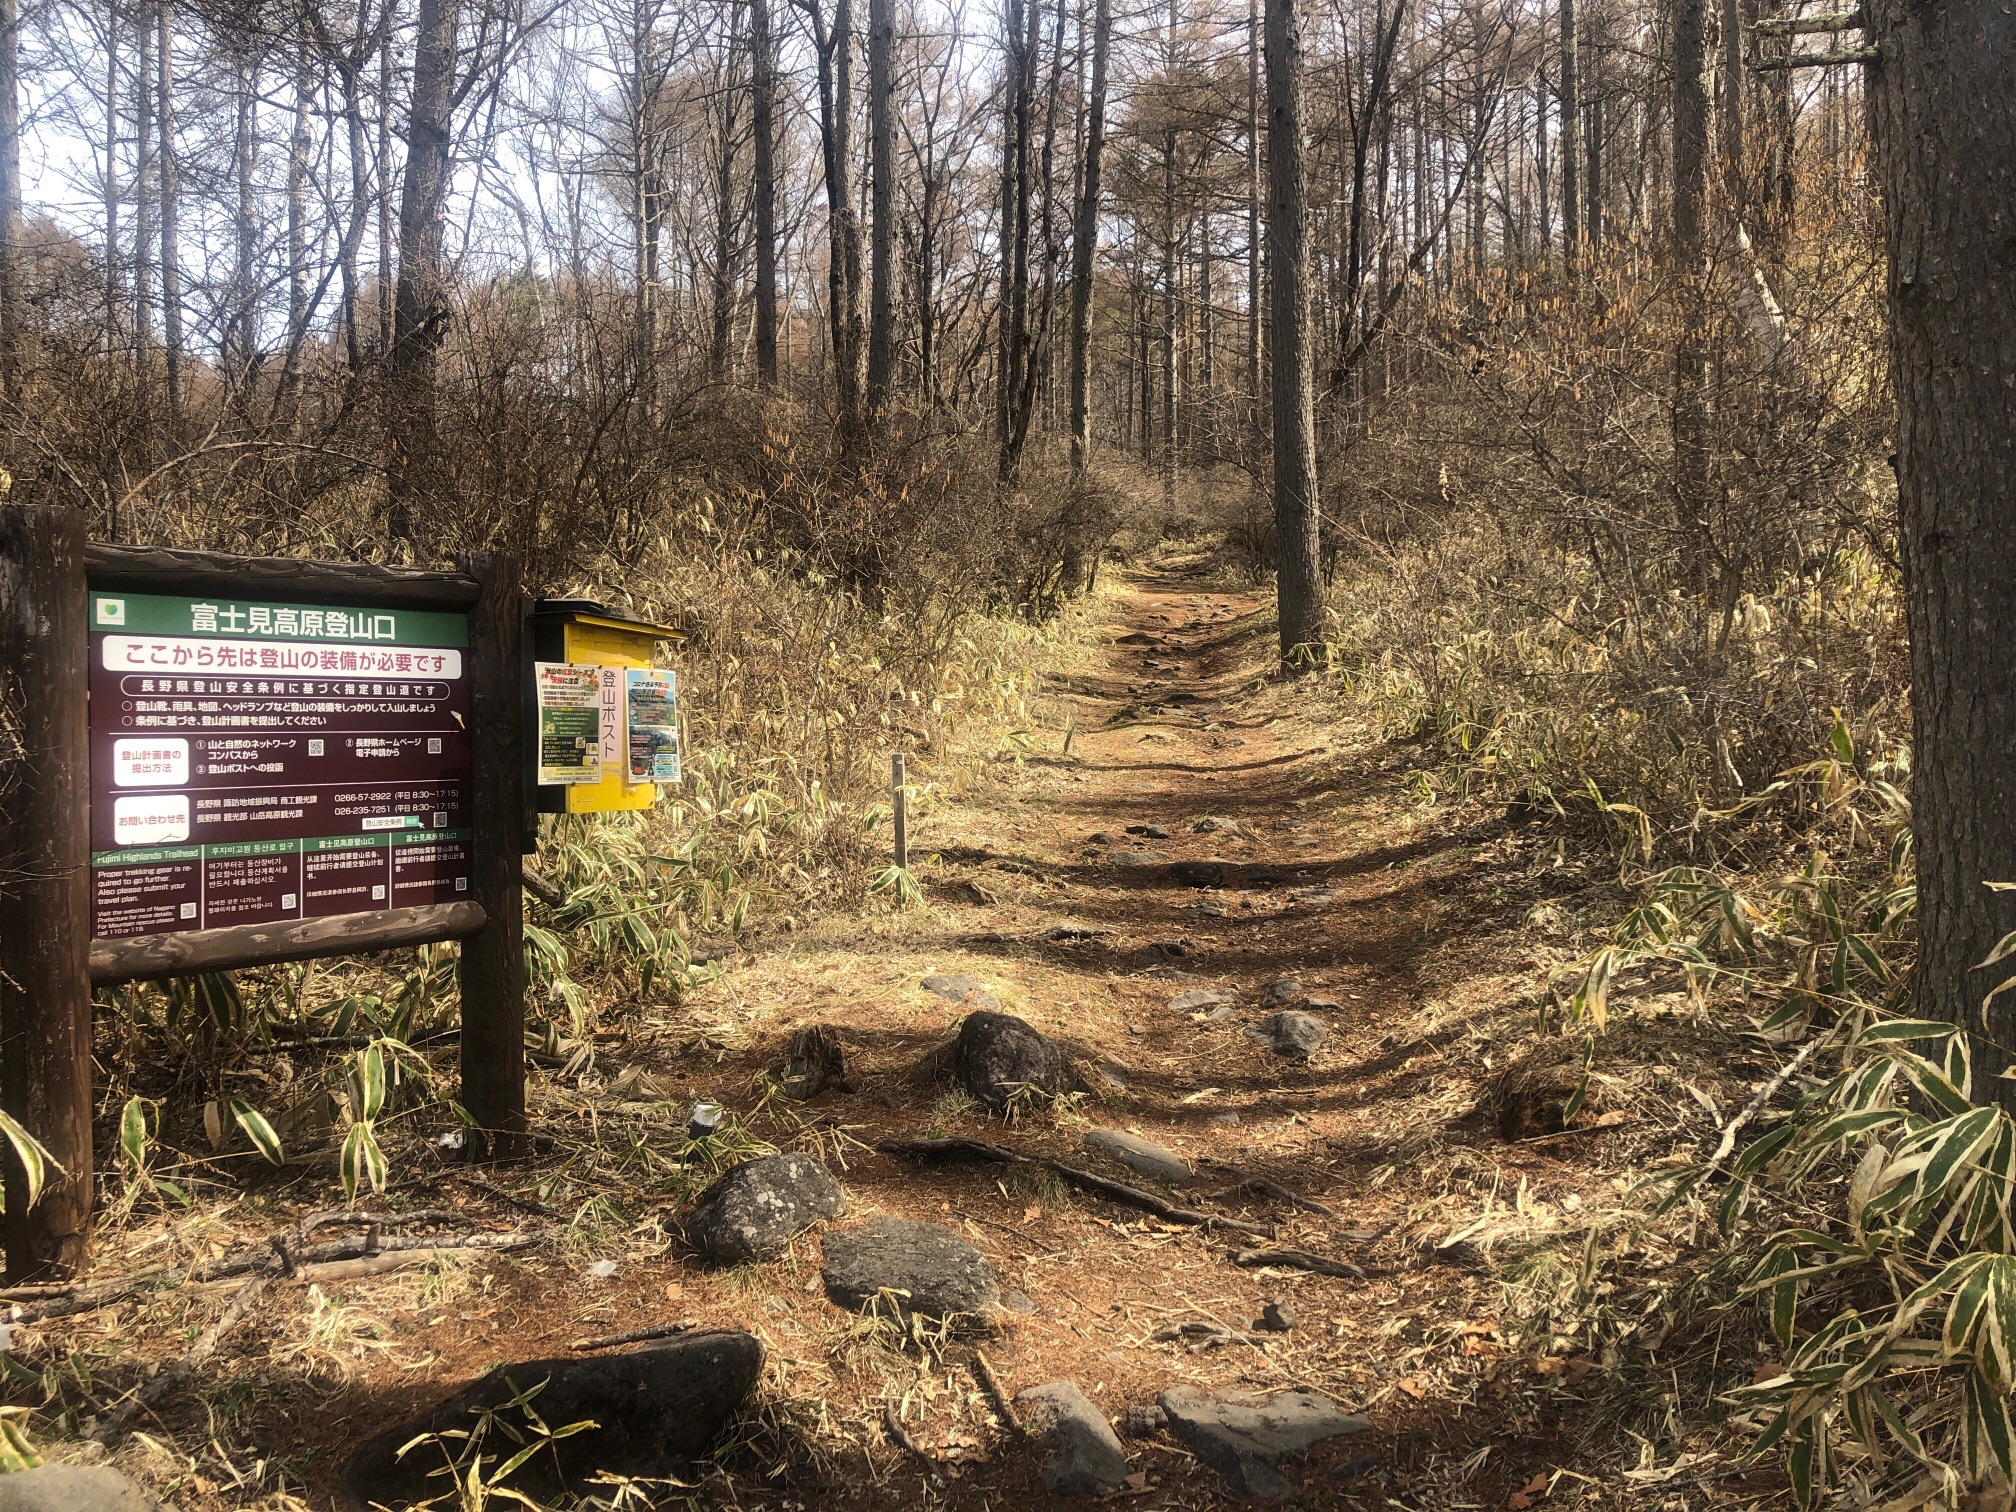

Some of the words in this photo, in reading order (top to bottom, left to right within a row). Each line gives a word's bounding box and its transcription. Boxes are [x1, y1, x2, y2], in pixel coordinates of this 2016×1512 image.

[190, 603, 396, 640] 富士見高原登山口
[126, 643, 447, 673] ここから先は登山の装備が必要です
[141, 679, 436, 696] 長野県登山安全条例に基づく指定登山道です
[135, 701, 436, 713] 登山靴、雨具、地図、ヘッドランプなど登山の装備をしっかりして入山しましょう
[602, 671, 616, 758] 登山ポスト
[135, 715, 327, 727] 条例に基づき、登山計画書を提出してください
[208, 738, 297, 750] 山と自然のネットワーク
[355, 737, 422, 748] 長野県ホームページ
[121, 750, 181, 761] 登山計画書の
[208, 750, 259, 760] コンパスから
[355, 748, 400, 758] 電子申請から
[132, 763, 172, 774] 提出方法
[208, 763, 284, 774] 登山ポストへの投函
[334, 792, 392, 803] 0266-57-2922
[196, 799, 222, 809] 長野県
[334, 805, 391, 816] 026-235-7251
[118, 814, 186, 827] お問い合わせ先
[196, 813, 222, 824] 長野県
[223, 812, 248, 822] 観光部
[365, 817, 402, 828] 登山安全条例
[318, 837, 375, 849] 富士见高原登山口
[406, 832, 457, 843] 富士見高原登山口
[211, 845, 251, 855] 후지미고원
[253, 843, 276, 853] 등산로
[279, 842, 294, 851] 입구
[97, 855, 121, 865] Fujimi
[123, 852, 162, 863] Highlands
[164, 849, 199, 858] Trailhead
[208, 860, 245, 870] 여기부터는
[98, 871, 123, 879] Proper
[125, 868, 155, 877] trekking
[156, 867, 173, 875] gear
[97, 879, 122, 888] quired
[144, 875, 171, 883] further.
[208, 880, 230, 889] 반드시
[116, 886, 142, 895] please
[143, 884, 168, 892] submit
[170, 882, 187, 890] your
[97, 897, 120, 905] travel
[121, 895, 139, 903] plan.
[108, 921, 135, 929] Mountain
